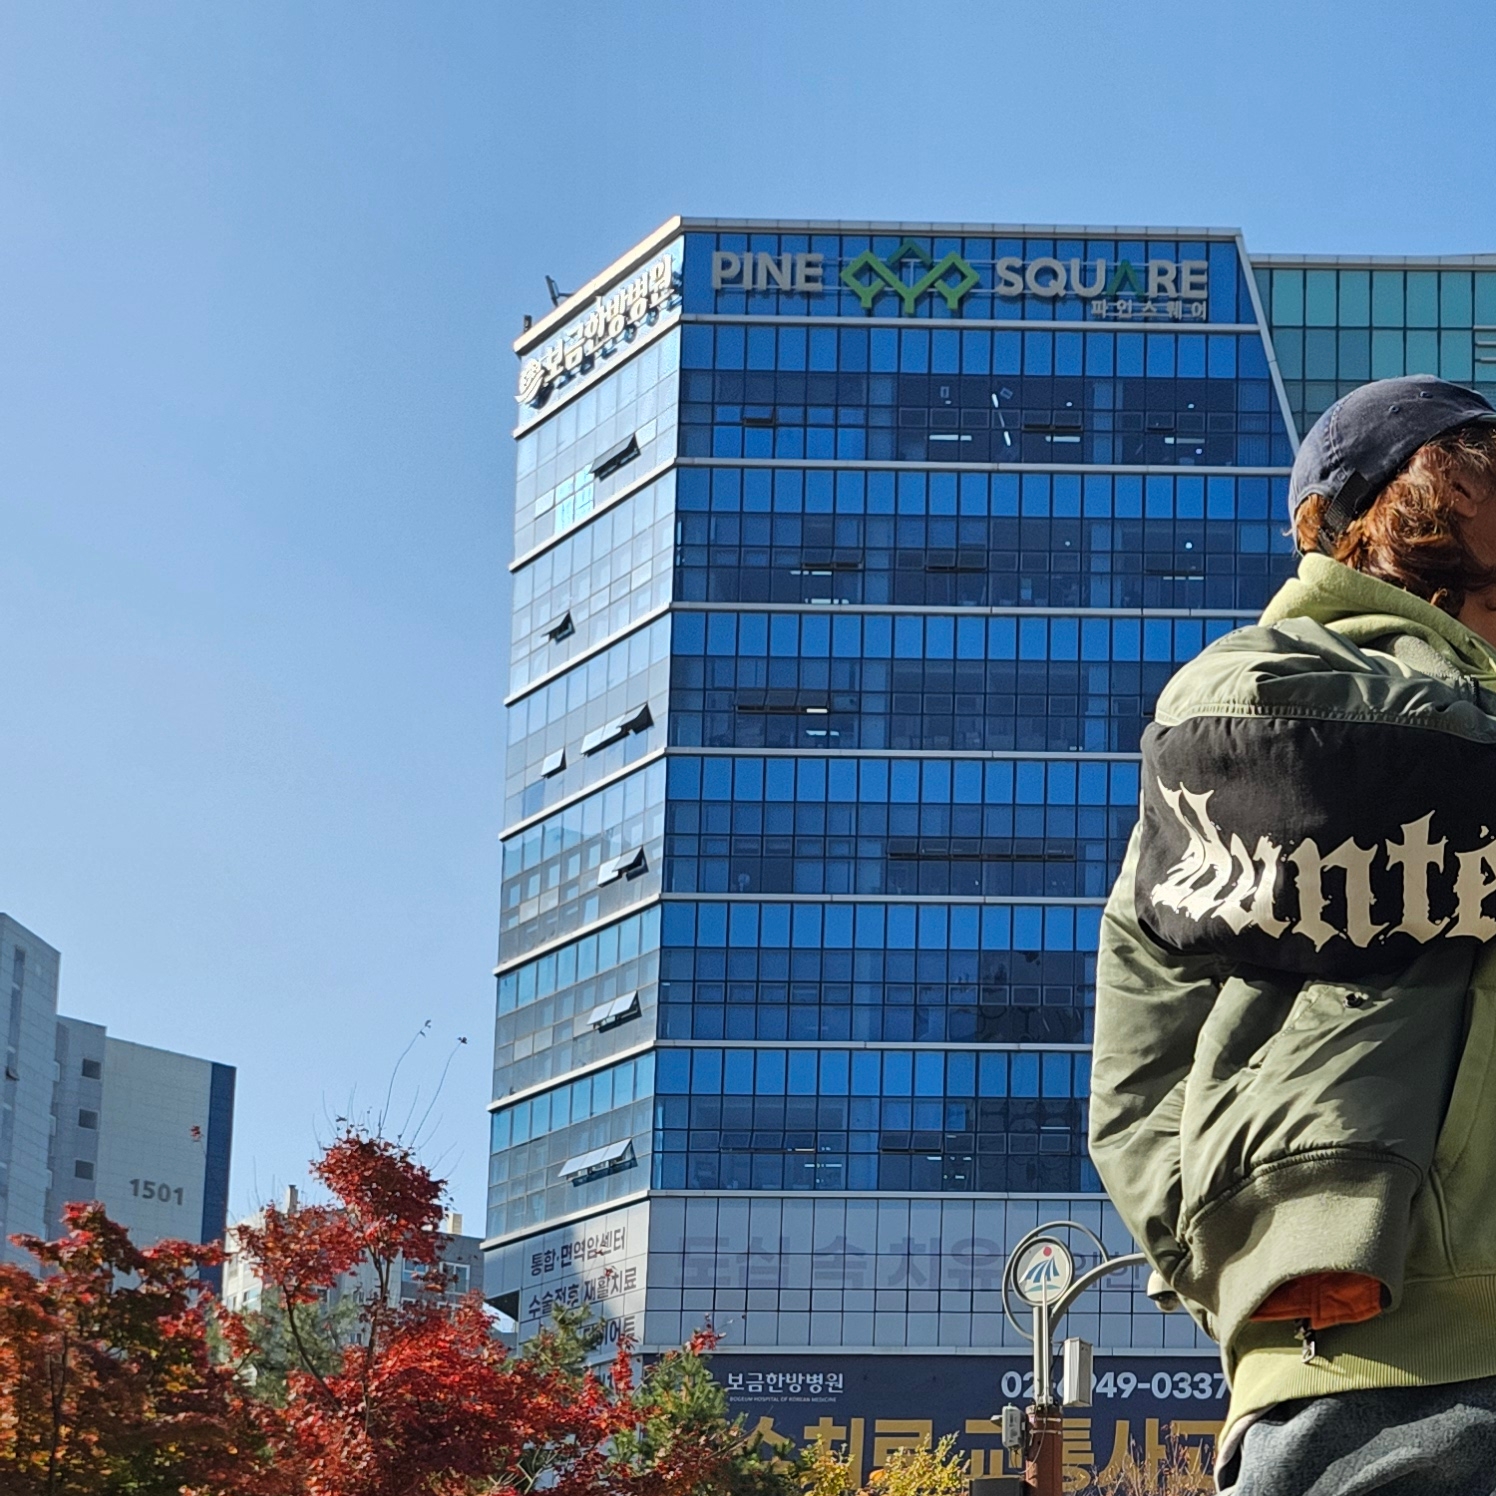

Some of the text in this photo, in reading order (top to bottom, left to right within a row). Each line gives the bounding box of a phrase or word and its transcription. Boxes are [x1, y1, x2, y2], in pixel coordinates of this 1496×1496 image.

[712, 251, 1208, 299] PINE SQUARE
[541, 253, 674, 383] 보금한방병원
[1091, 299, 1207, 320] 파인스퀘어
[129, 1179, 184, 1206] 1501
[675, 1236, 791, 1289] 도심
[812, 1236, 867, 1292] 속
[584, 1266, 637, 1302] 재활치료
[727, 1372, 845, 1394] 보금한방병원
